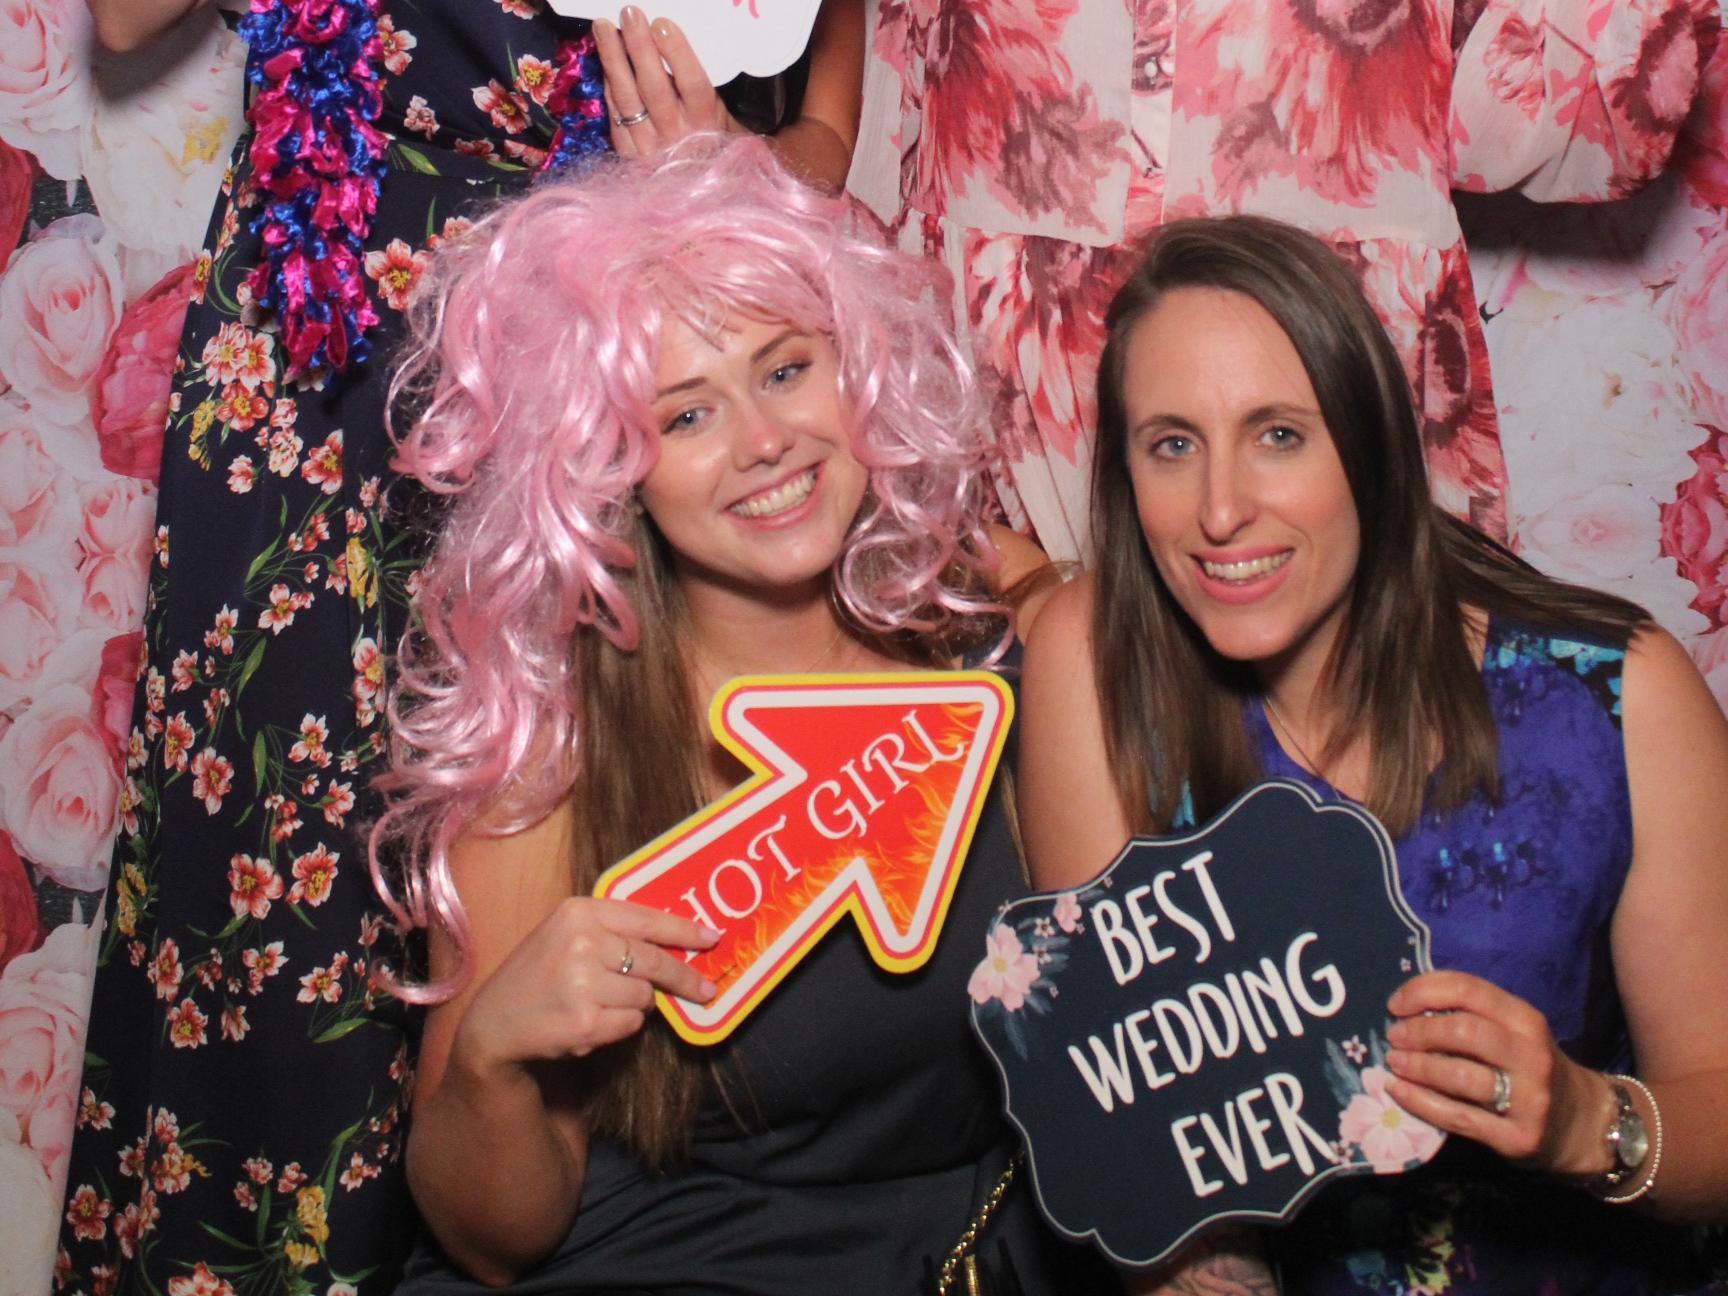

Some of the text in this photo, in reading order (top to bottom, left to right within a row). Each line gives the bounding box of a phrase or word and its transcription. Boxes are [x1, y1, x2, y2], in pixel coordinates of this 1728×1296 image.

[806, 709, 966, 840] GIRL
[1091, 850, 1235, 986] BEST
[1067, 932, 1346, 1113] WEDDING
[1171, 1072, 1338, 1197] EVER
